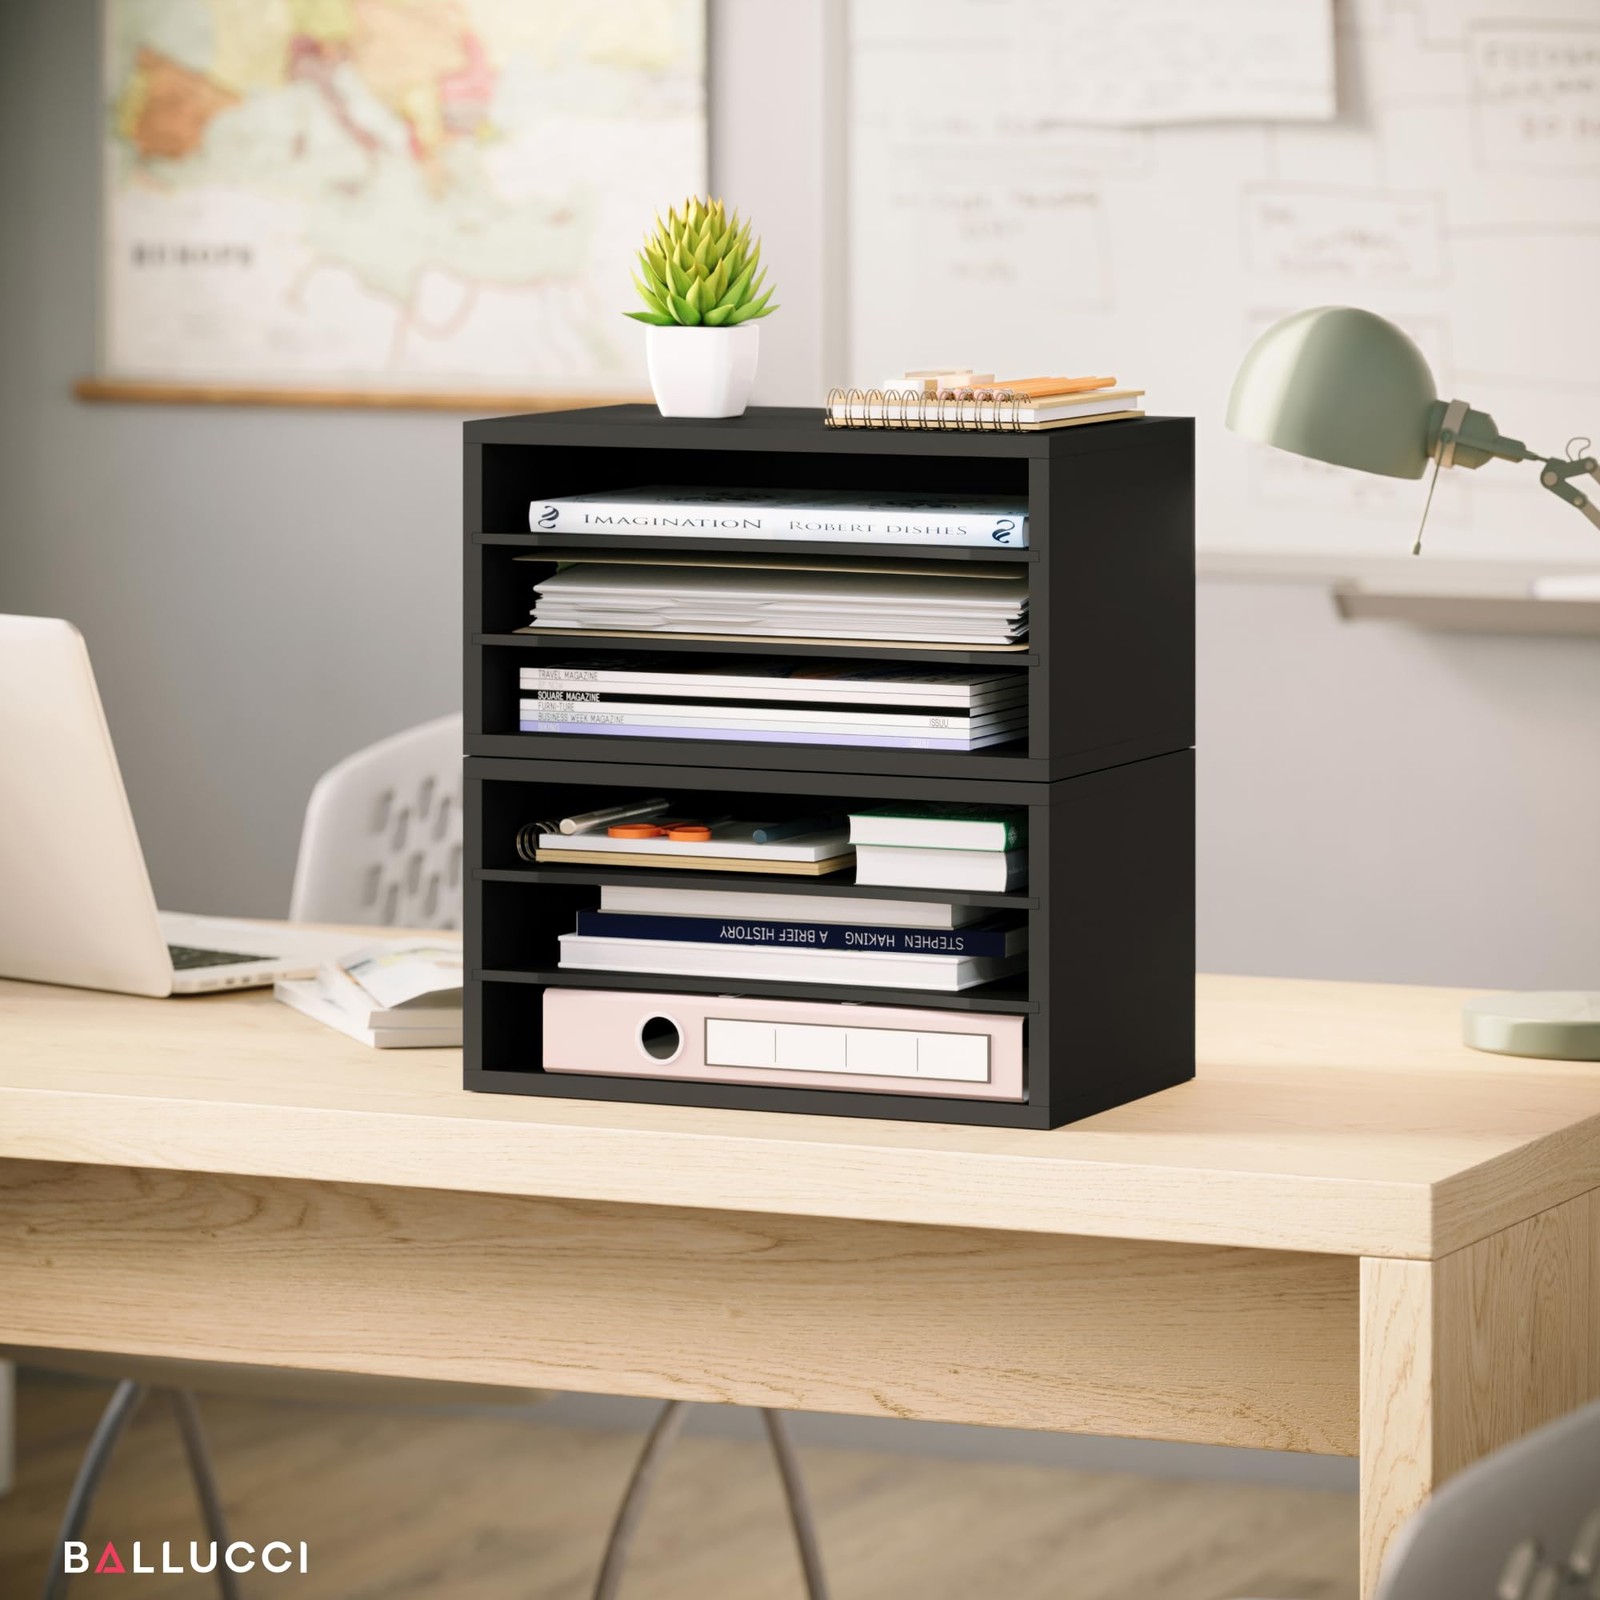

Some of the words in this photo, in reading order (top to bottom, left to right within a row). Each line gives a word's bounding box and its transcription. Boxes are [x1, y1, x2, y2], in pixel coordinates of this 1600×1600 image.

[584, 513, 762, 529] IMAGINATION
[789, 520, 874, 533] ROBERT
[886, 524, 968, 536] DISHES
[538, 669, 562, 680] TRAVEL
[564, 671, 598, 681] MAGAZINE
[537, 690, 564, 701] SQUARE
[565, 692, 600, 703] MAGAZINE
[538, 712, 568, 722] BUSINESS
[570, 713, 589, 724] WEEK
[591, 714, 625, 725] MAGAZINE
[719, 925, 775, 940] HISTORY
[779, 928, 816, 943] BRIEF
[819, 930, 829, 944] A
[845, 931, 896, 947] HAKING
[904, 935, 965, 951] STEPHEN
